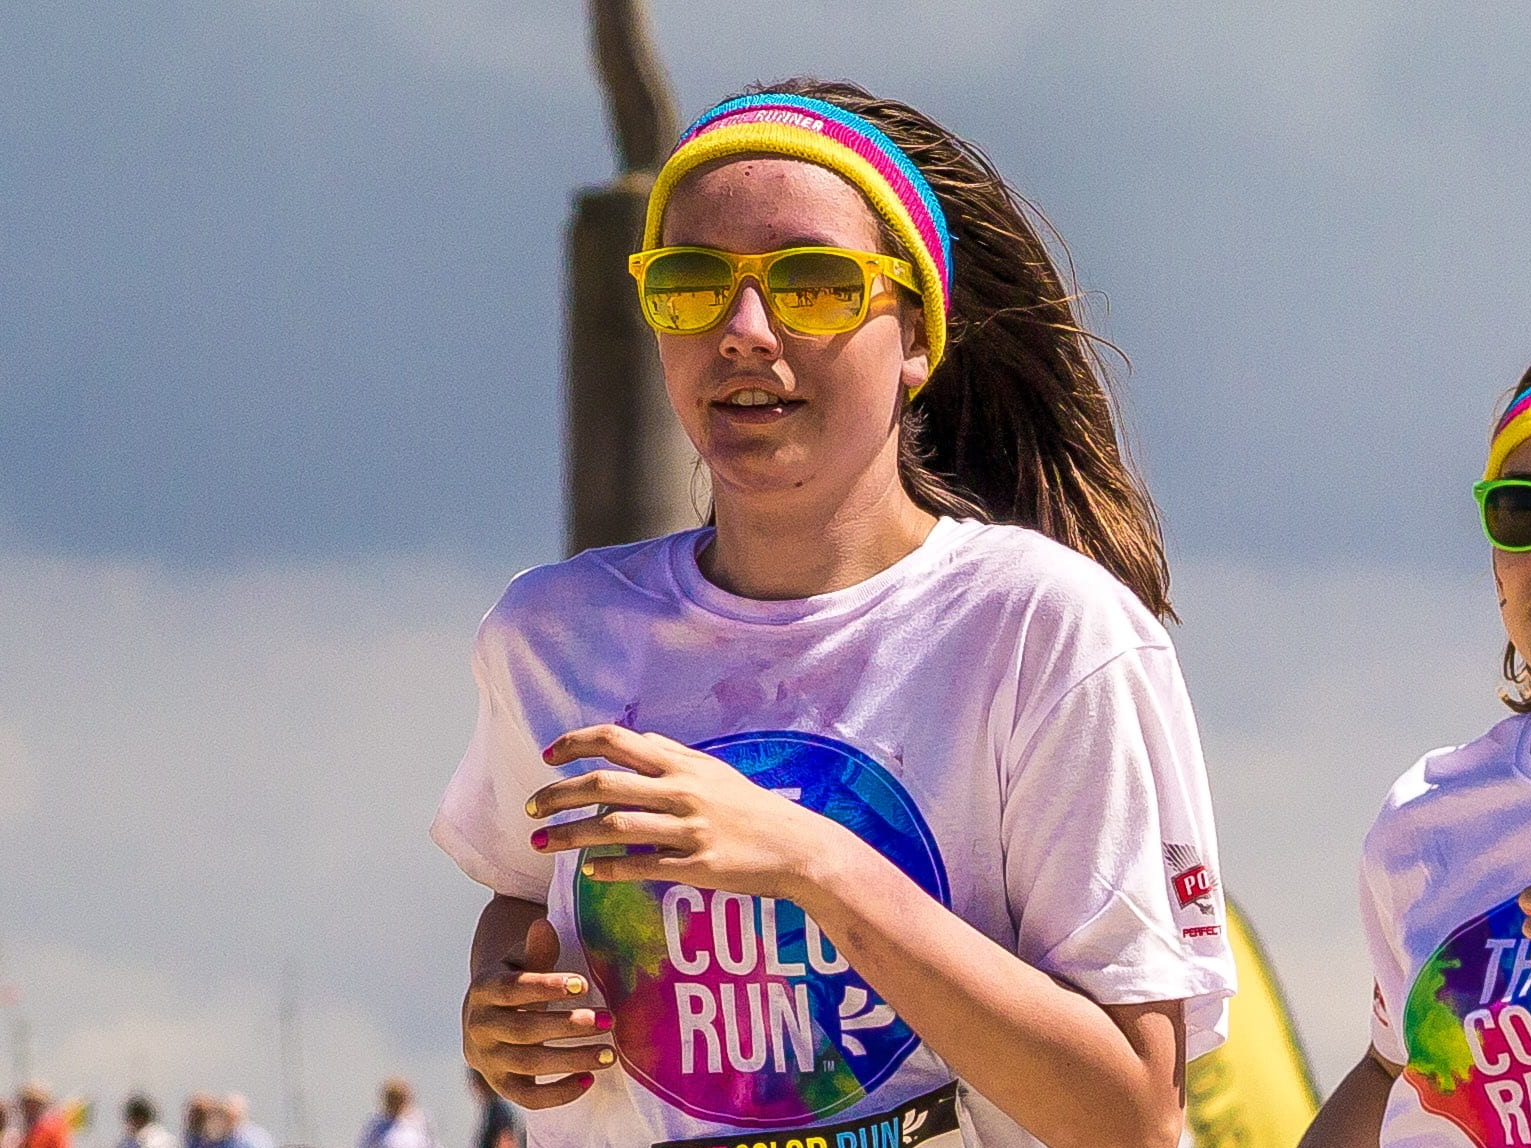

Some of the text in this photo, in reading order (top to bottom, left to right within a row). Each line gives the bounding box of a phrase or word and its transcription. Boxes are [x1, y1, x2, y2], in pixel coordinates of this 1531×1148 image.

[755, 109, 824, 132] RUNNER
[662, 884, 850, 976] COLO
[674, 982, 815, 1075] RUN
